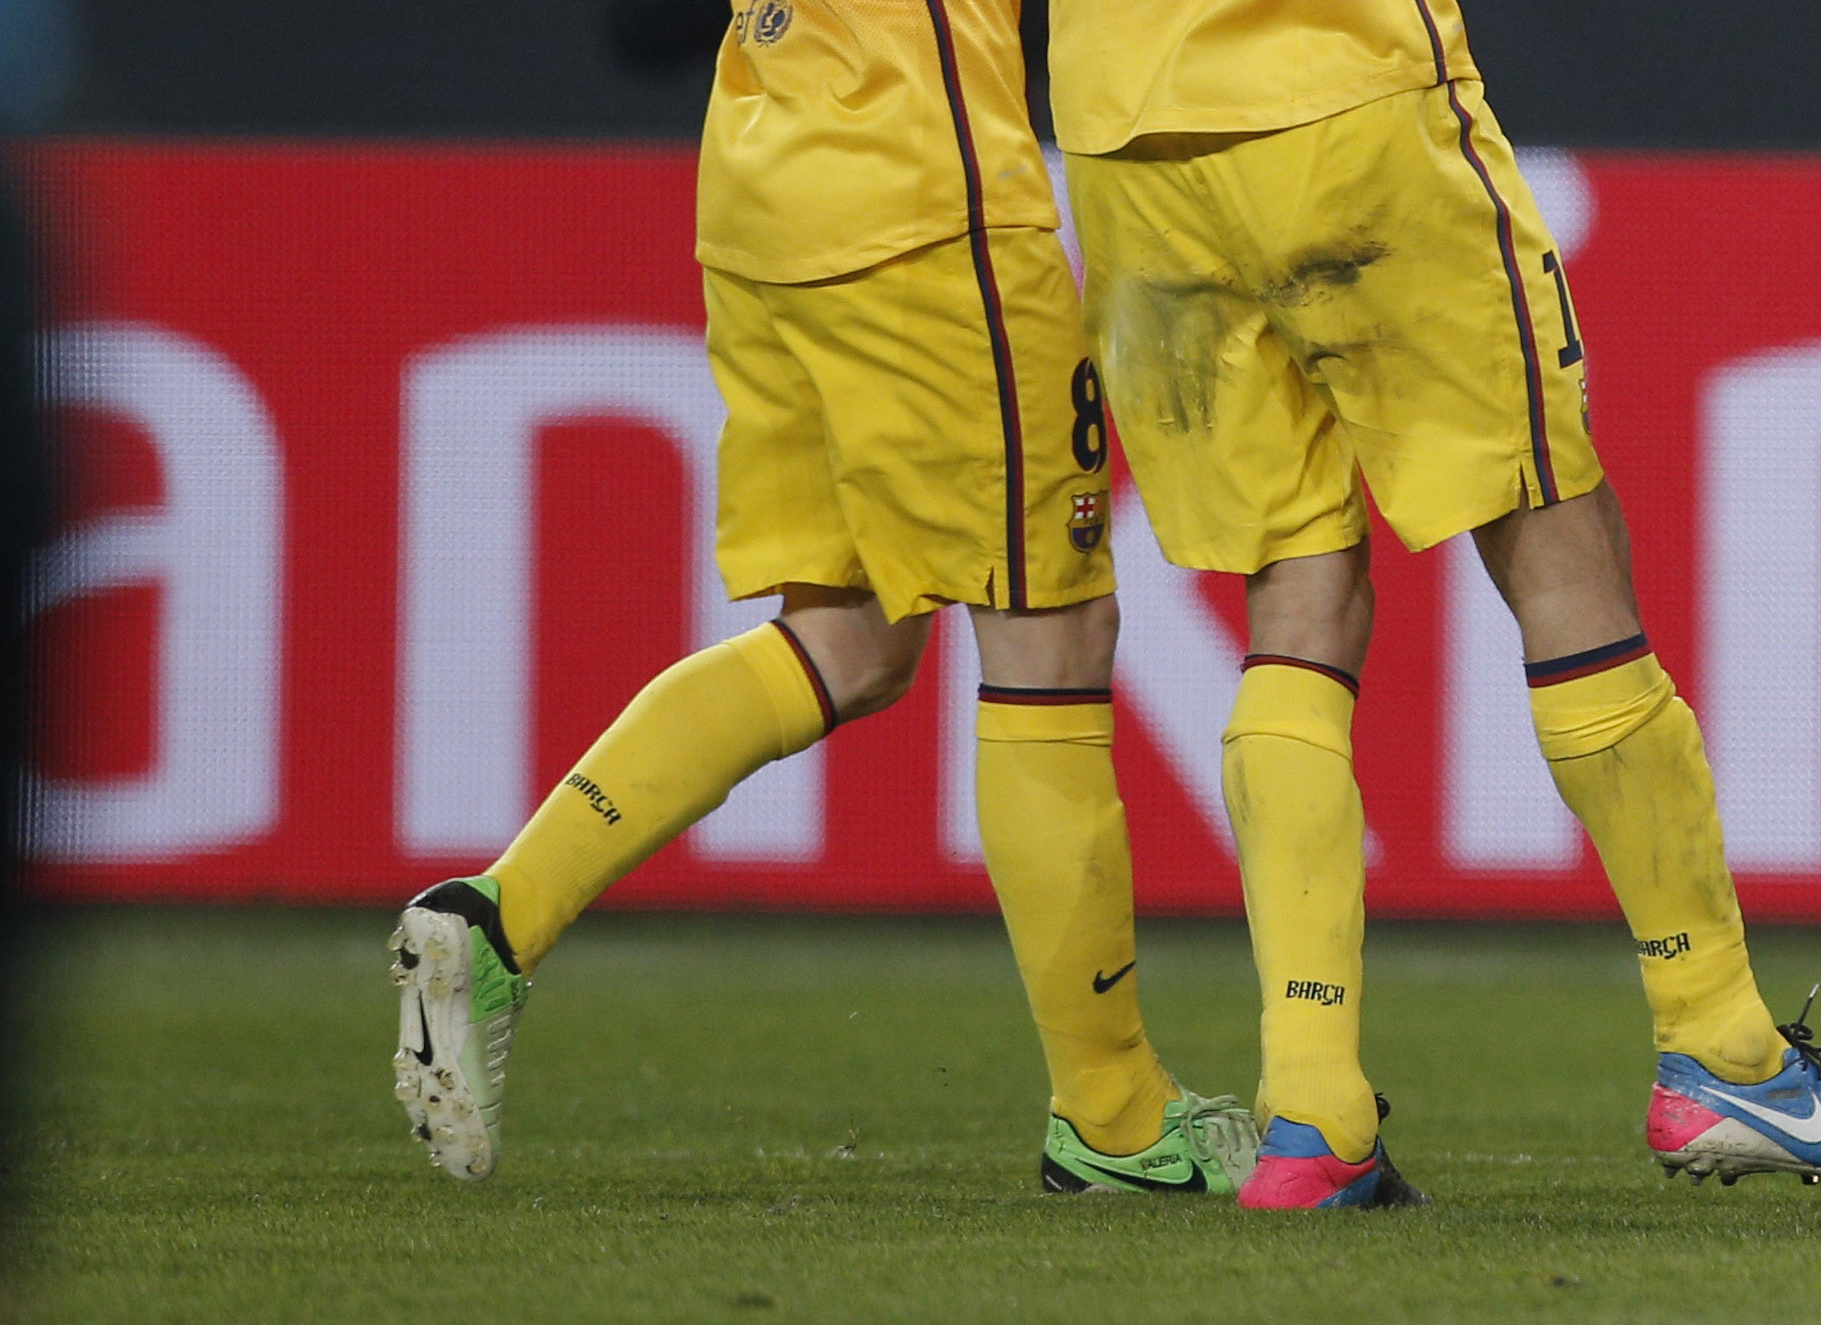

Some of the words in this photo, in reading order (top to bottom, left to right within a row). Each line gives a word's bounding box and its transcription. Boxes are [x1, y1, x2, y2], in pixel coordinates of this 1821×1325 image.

[1071, 356, 1108, 474] 8
[1636, 932, 1691, 960] ARÇA
[1286, 980, 1346, 1006] BARÇA
